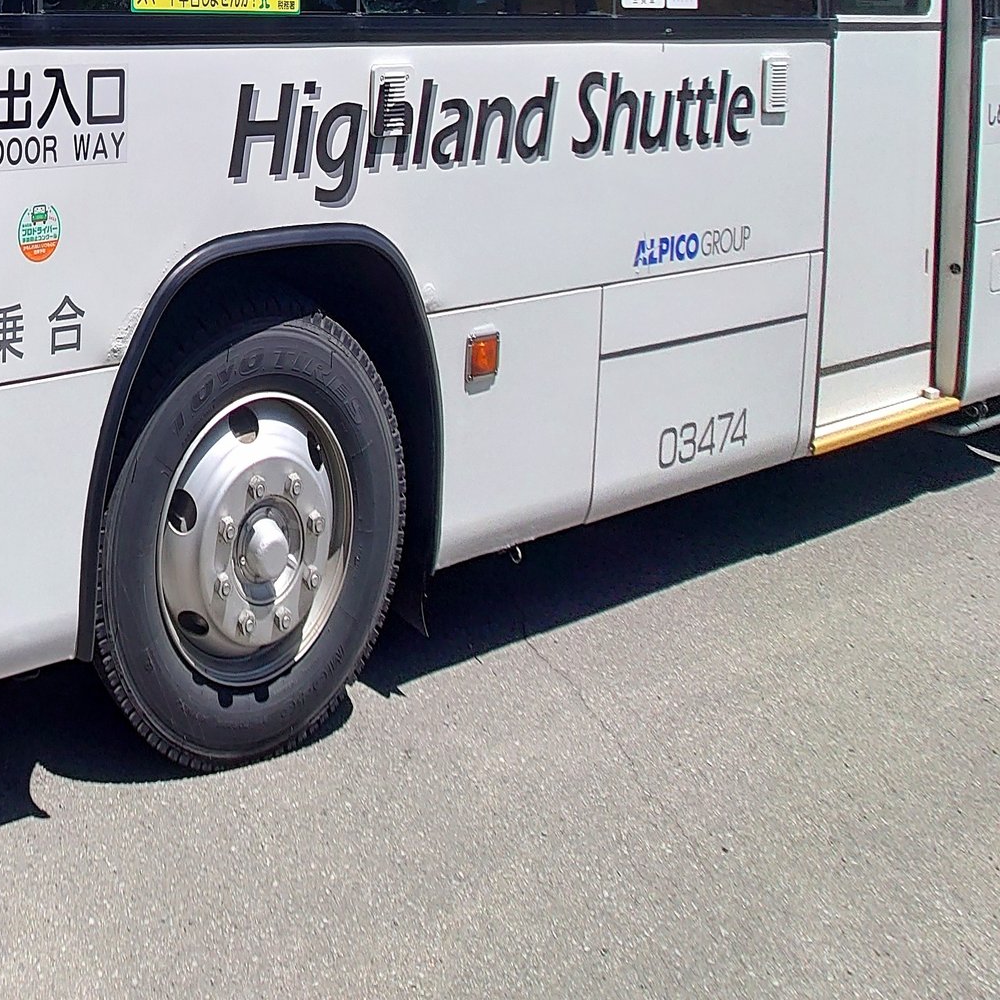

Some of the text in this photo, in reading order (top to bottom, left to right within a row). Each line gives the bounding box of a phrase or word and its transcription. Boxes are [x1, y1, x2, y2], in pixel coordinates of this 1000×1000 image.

[74, 131, 126, 162] WAY
[228, 69, 757, 207] Highland Shuttle
[633, 225, 751, 267] ALPICO GROUP
[658, 408, 748, 470] 03474
